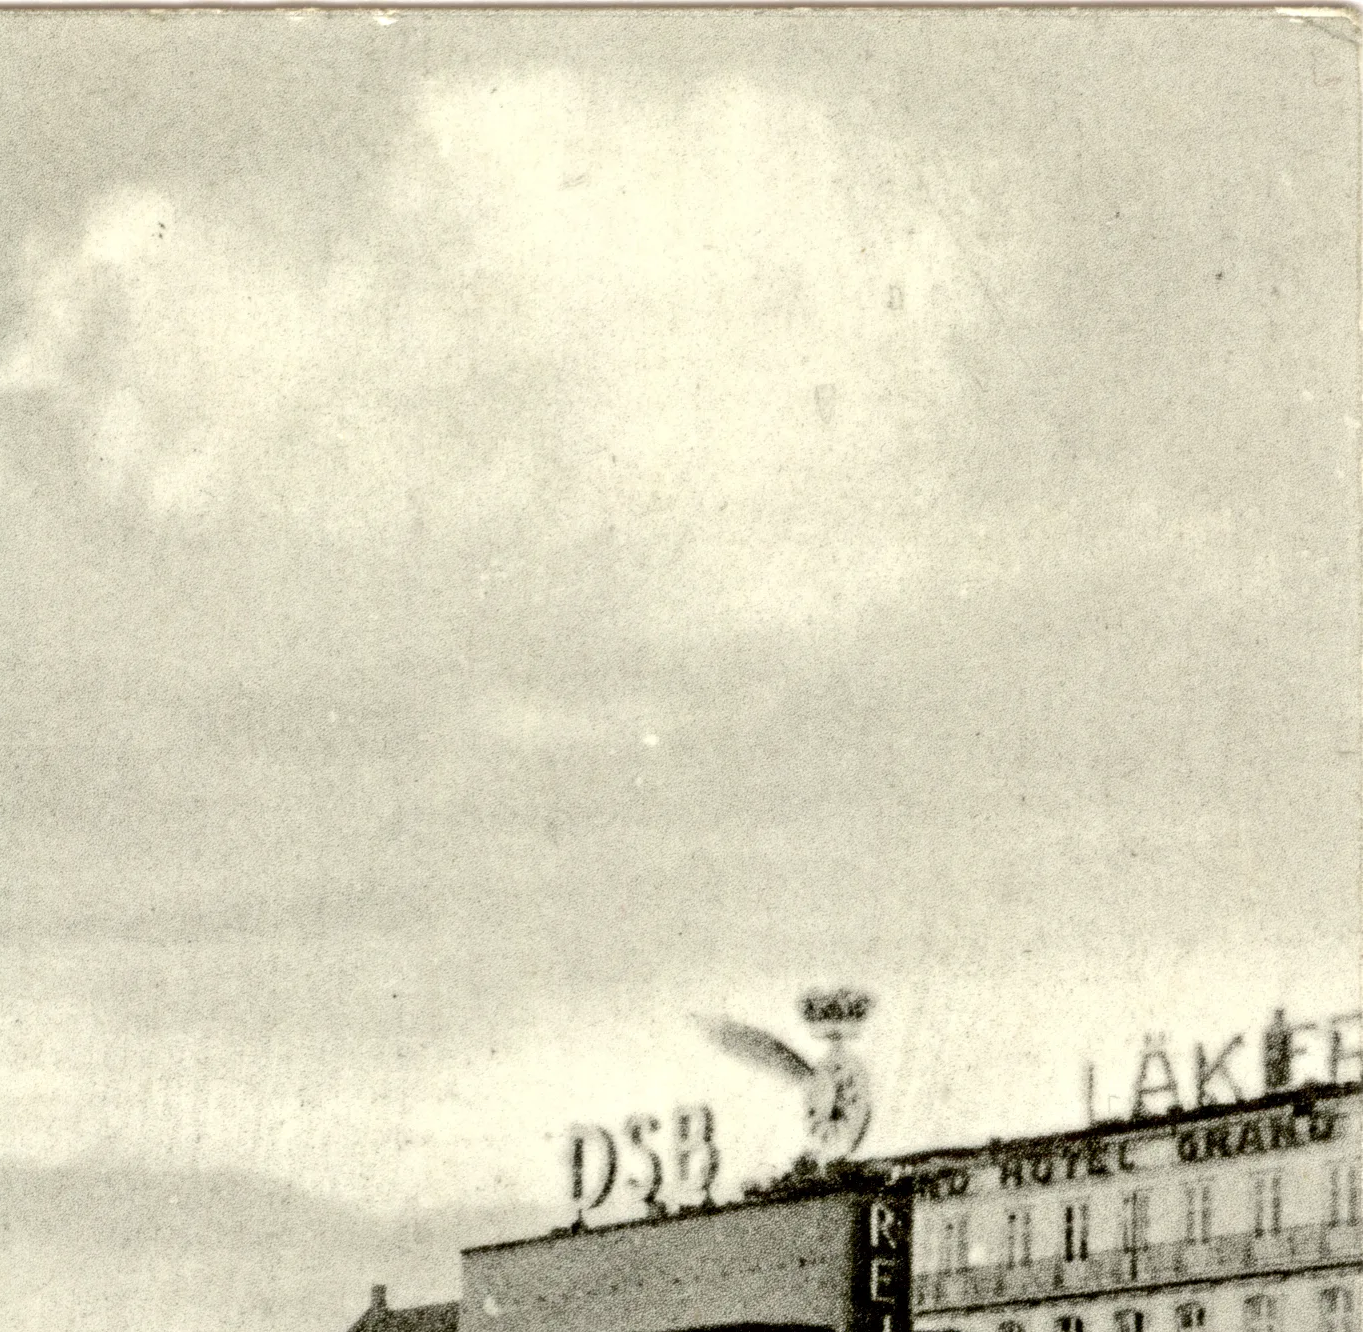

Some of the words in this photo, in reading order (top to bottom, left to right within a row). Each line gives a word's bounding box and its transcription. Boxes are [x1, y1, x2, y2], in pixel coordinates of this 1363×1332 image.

[567, 1106, 720, 1210] DSB
[999, 1144, 1136, 1188] HOTEL
[1178, 1112, 1339, 1163] GRAND
